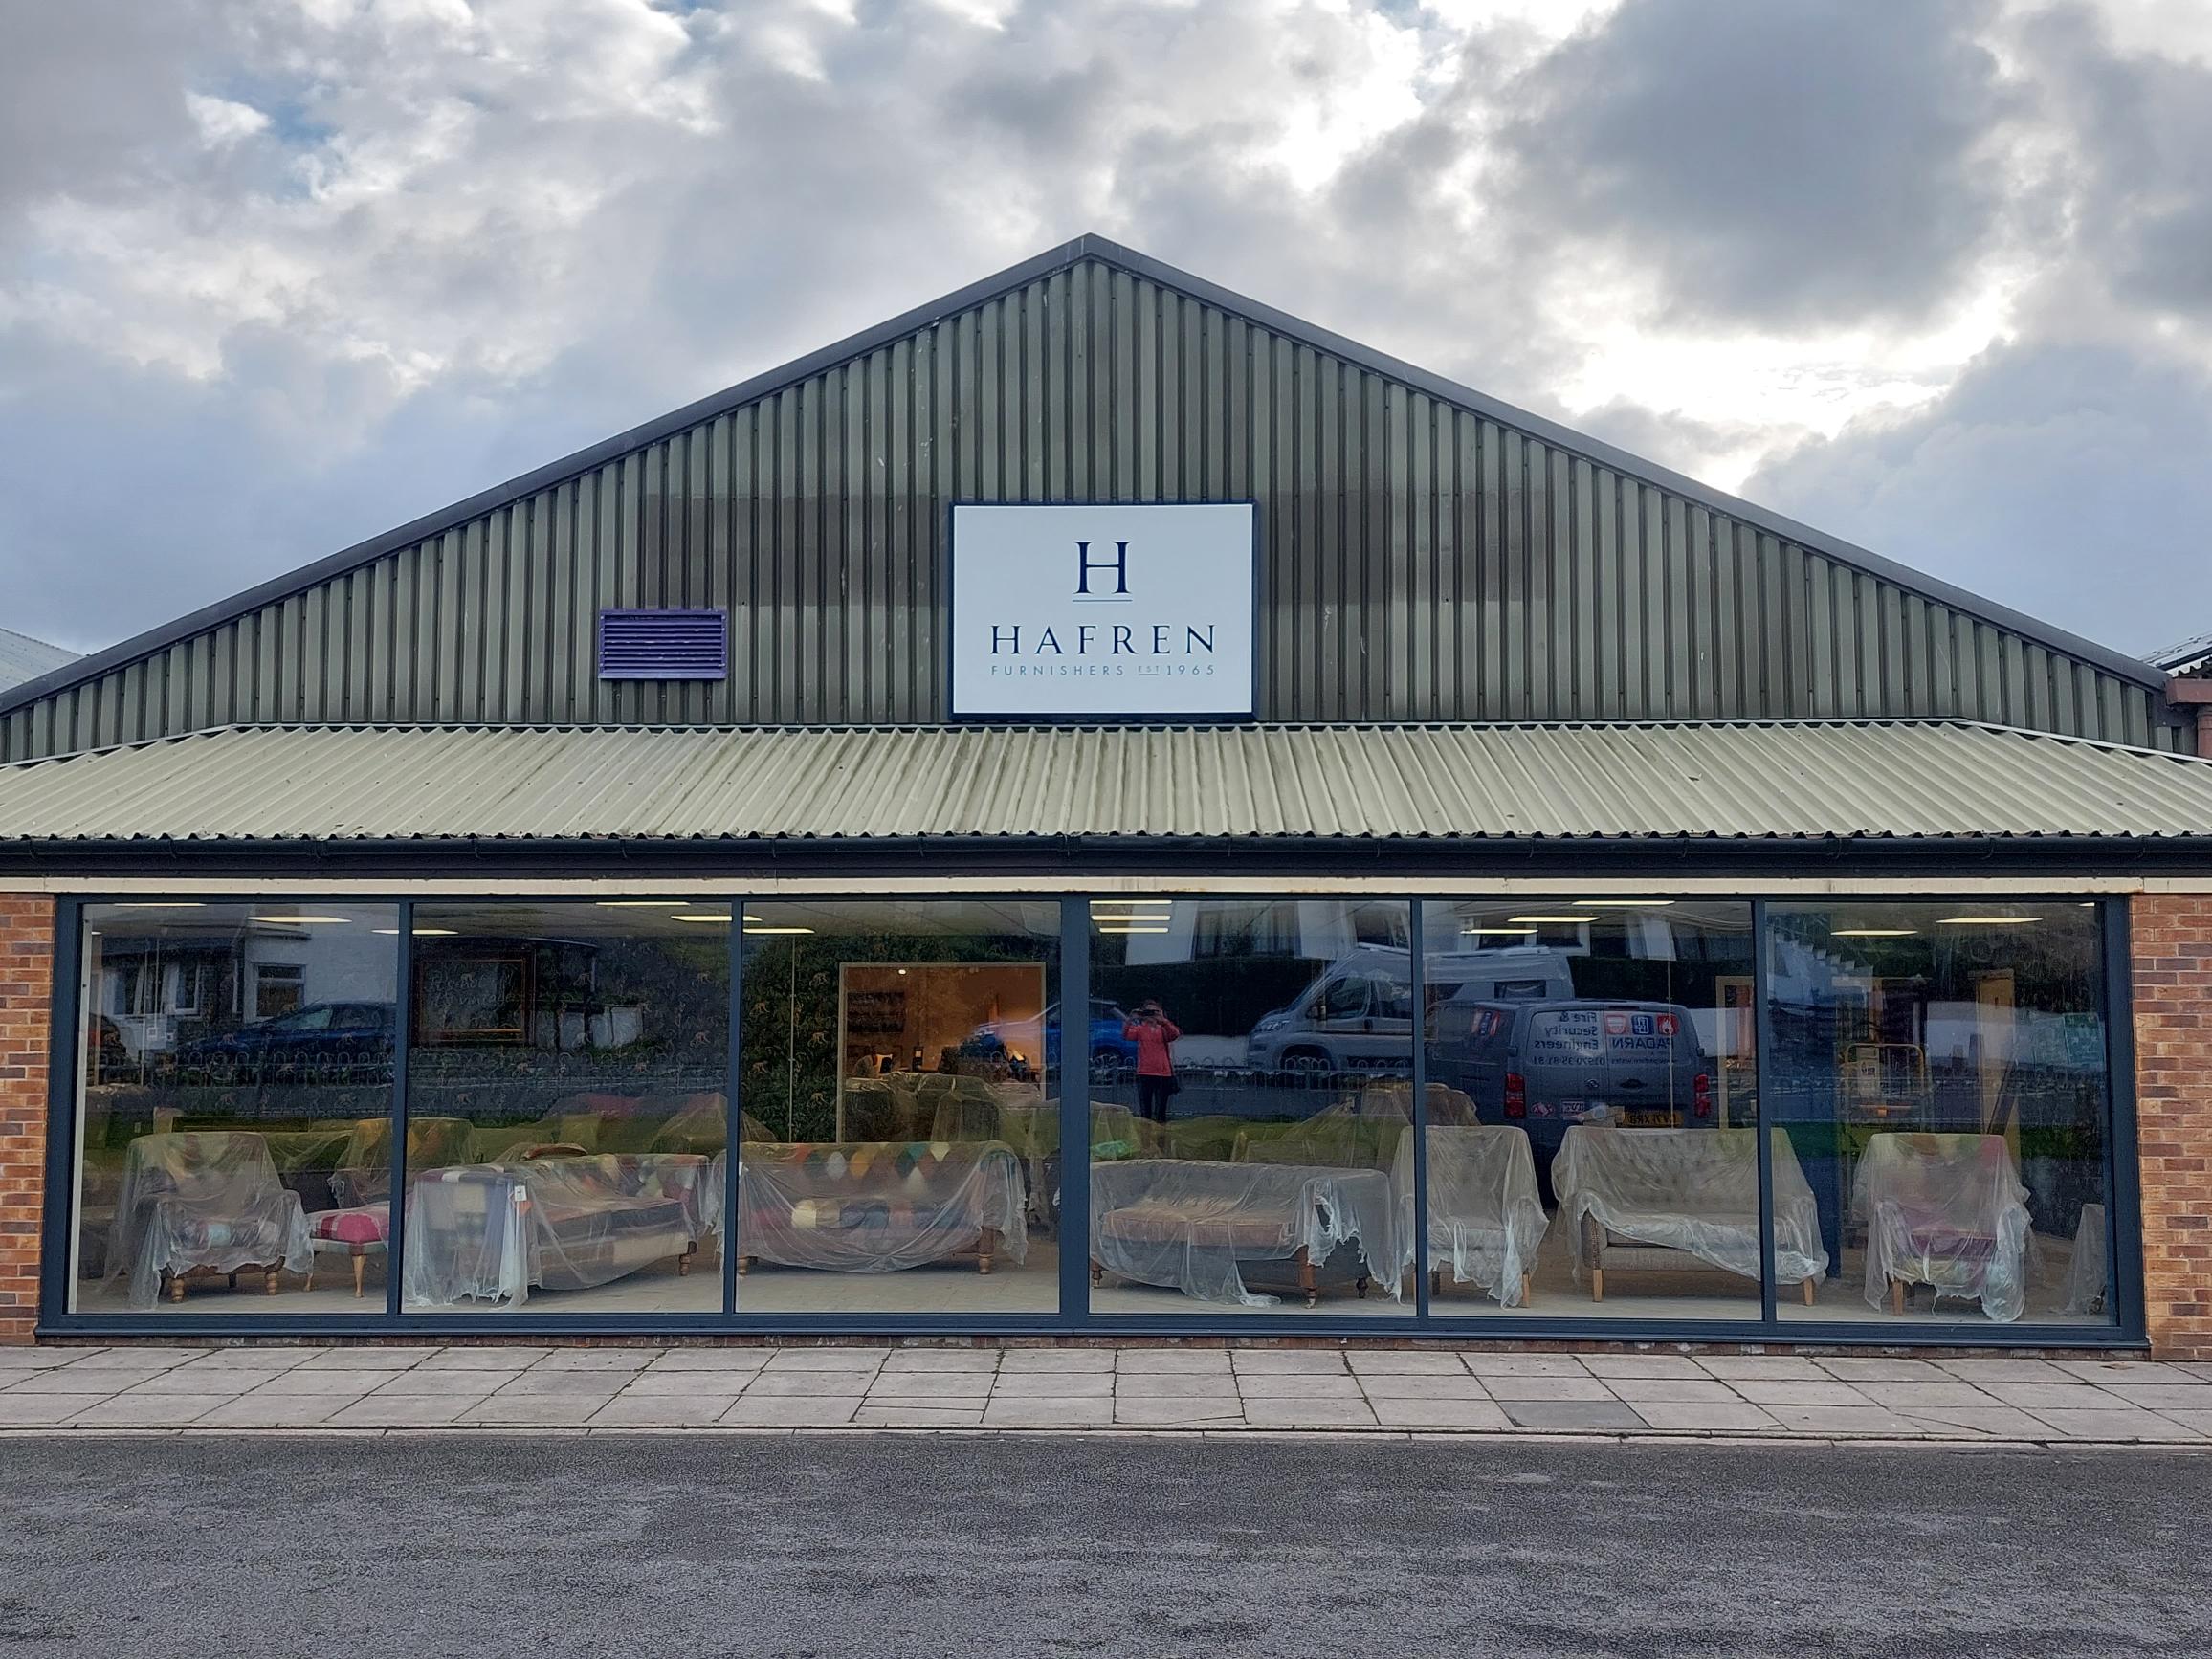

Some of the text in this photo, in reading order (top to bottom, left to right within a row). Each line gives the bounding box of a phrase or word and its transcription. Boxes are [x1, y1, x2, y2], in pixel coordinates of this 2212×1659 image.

[1073, 541, 1133, 594] H
[990, 624, 1215, 655] HAFREN
[991, 665, 1124, 675] FURNISHERS
[1166, 665, 1214, 675] 1965
